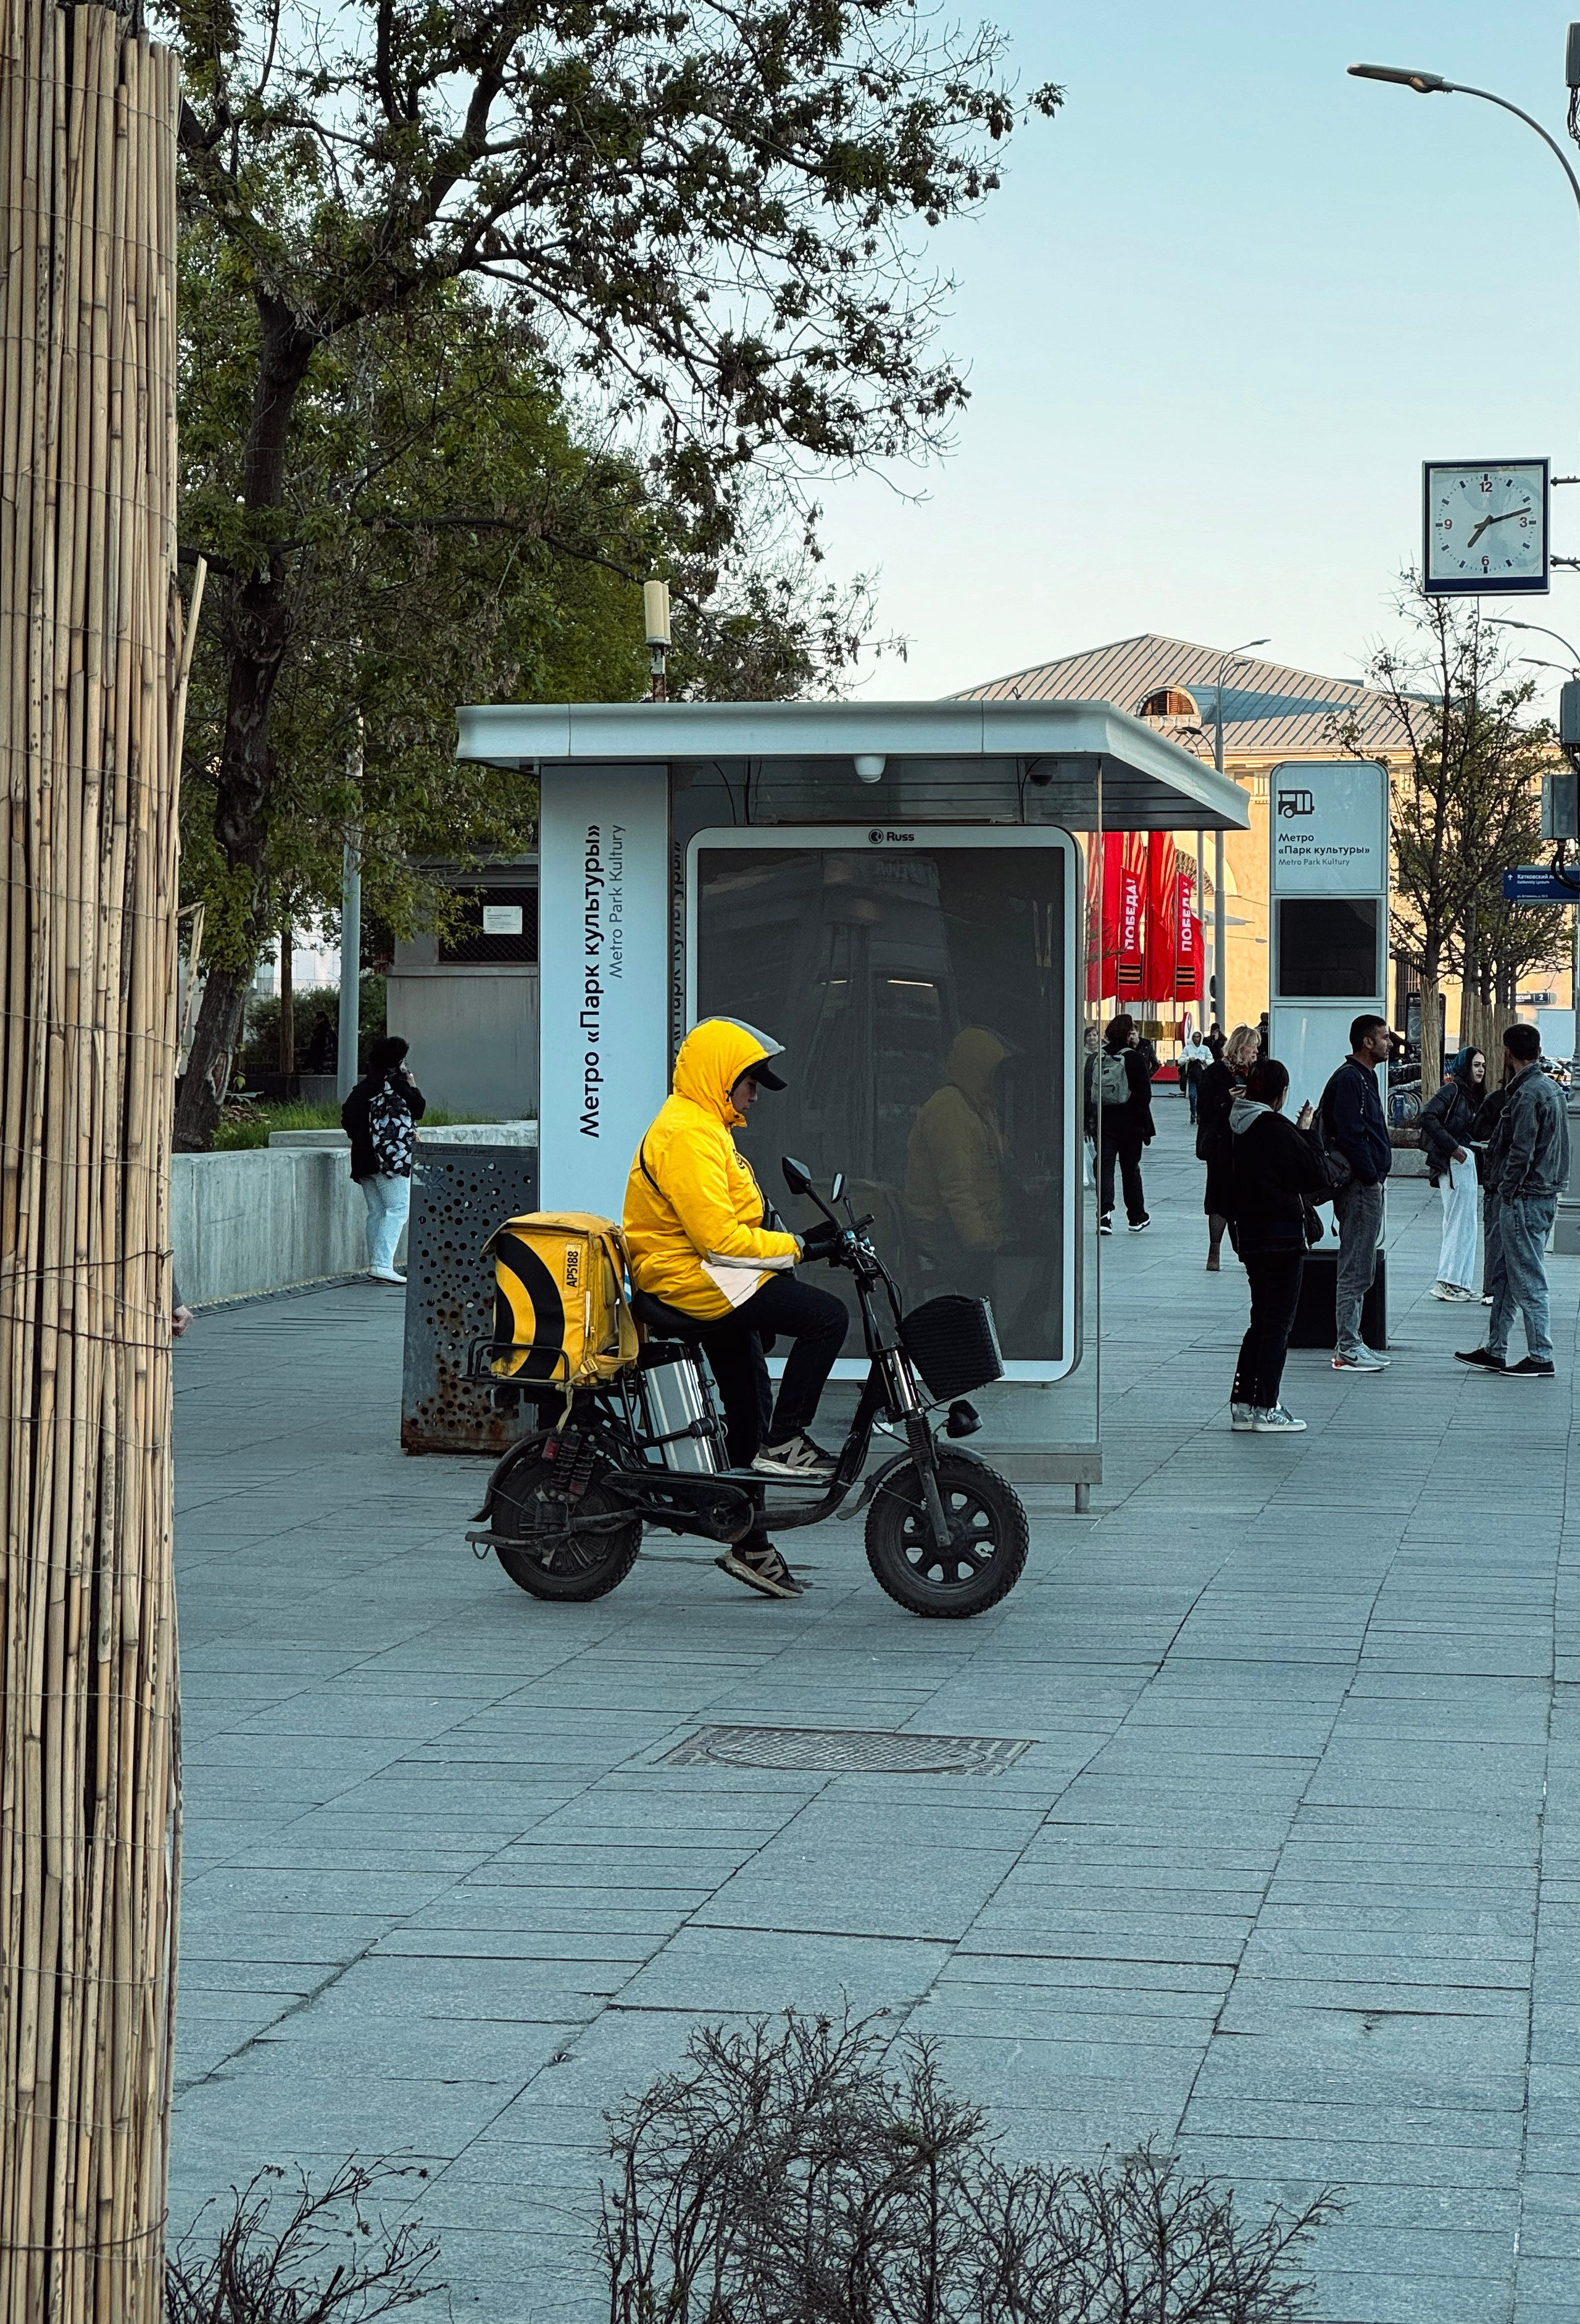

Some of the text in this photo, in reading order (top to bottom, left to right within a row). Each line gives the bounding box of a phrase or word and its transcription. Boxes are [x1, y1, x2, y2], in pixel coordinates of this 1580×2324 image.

[1479, 481, 1493, 493] 12
[1444, 519, 1453, 530] 9
[1519, 517, 1528, 528] 3
[1481, 556, 1490, 566] 6
[886, 831, 915, 841] Russ
[1278, 833, 1315, 844] Метро
[1278, 845, 1370, 856] «Парк культуры»
[1322, 859, 1350, 867] Kultury
[608, 825, 626, 978] Metro Park Kultury
[1125, 878, 1139, 950] ПОБЕДА!
[580, 825, 604, 1138] Метро «Парк культуры»
[566, 1251, 579, 1288] AP5188
